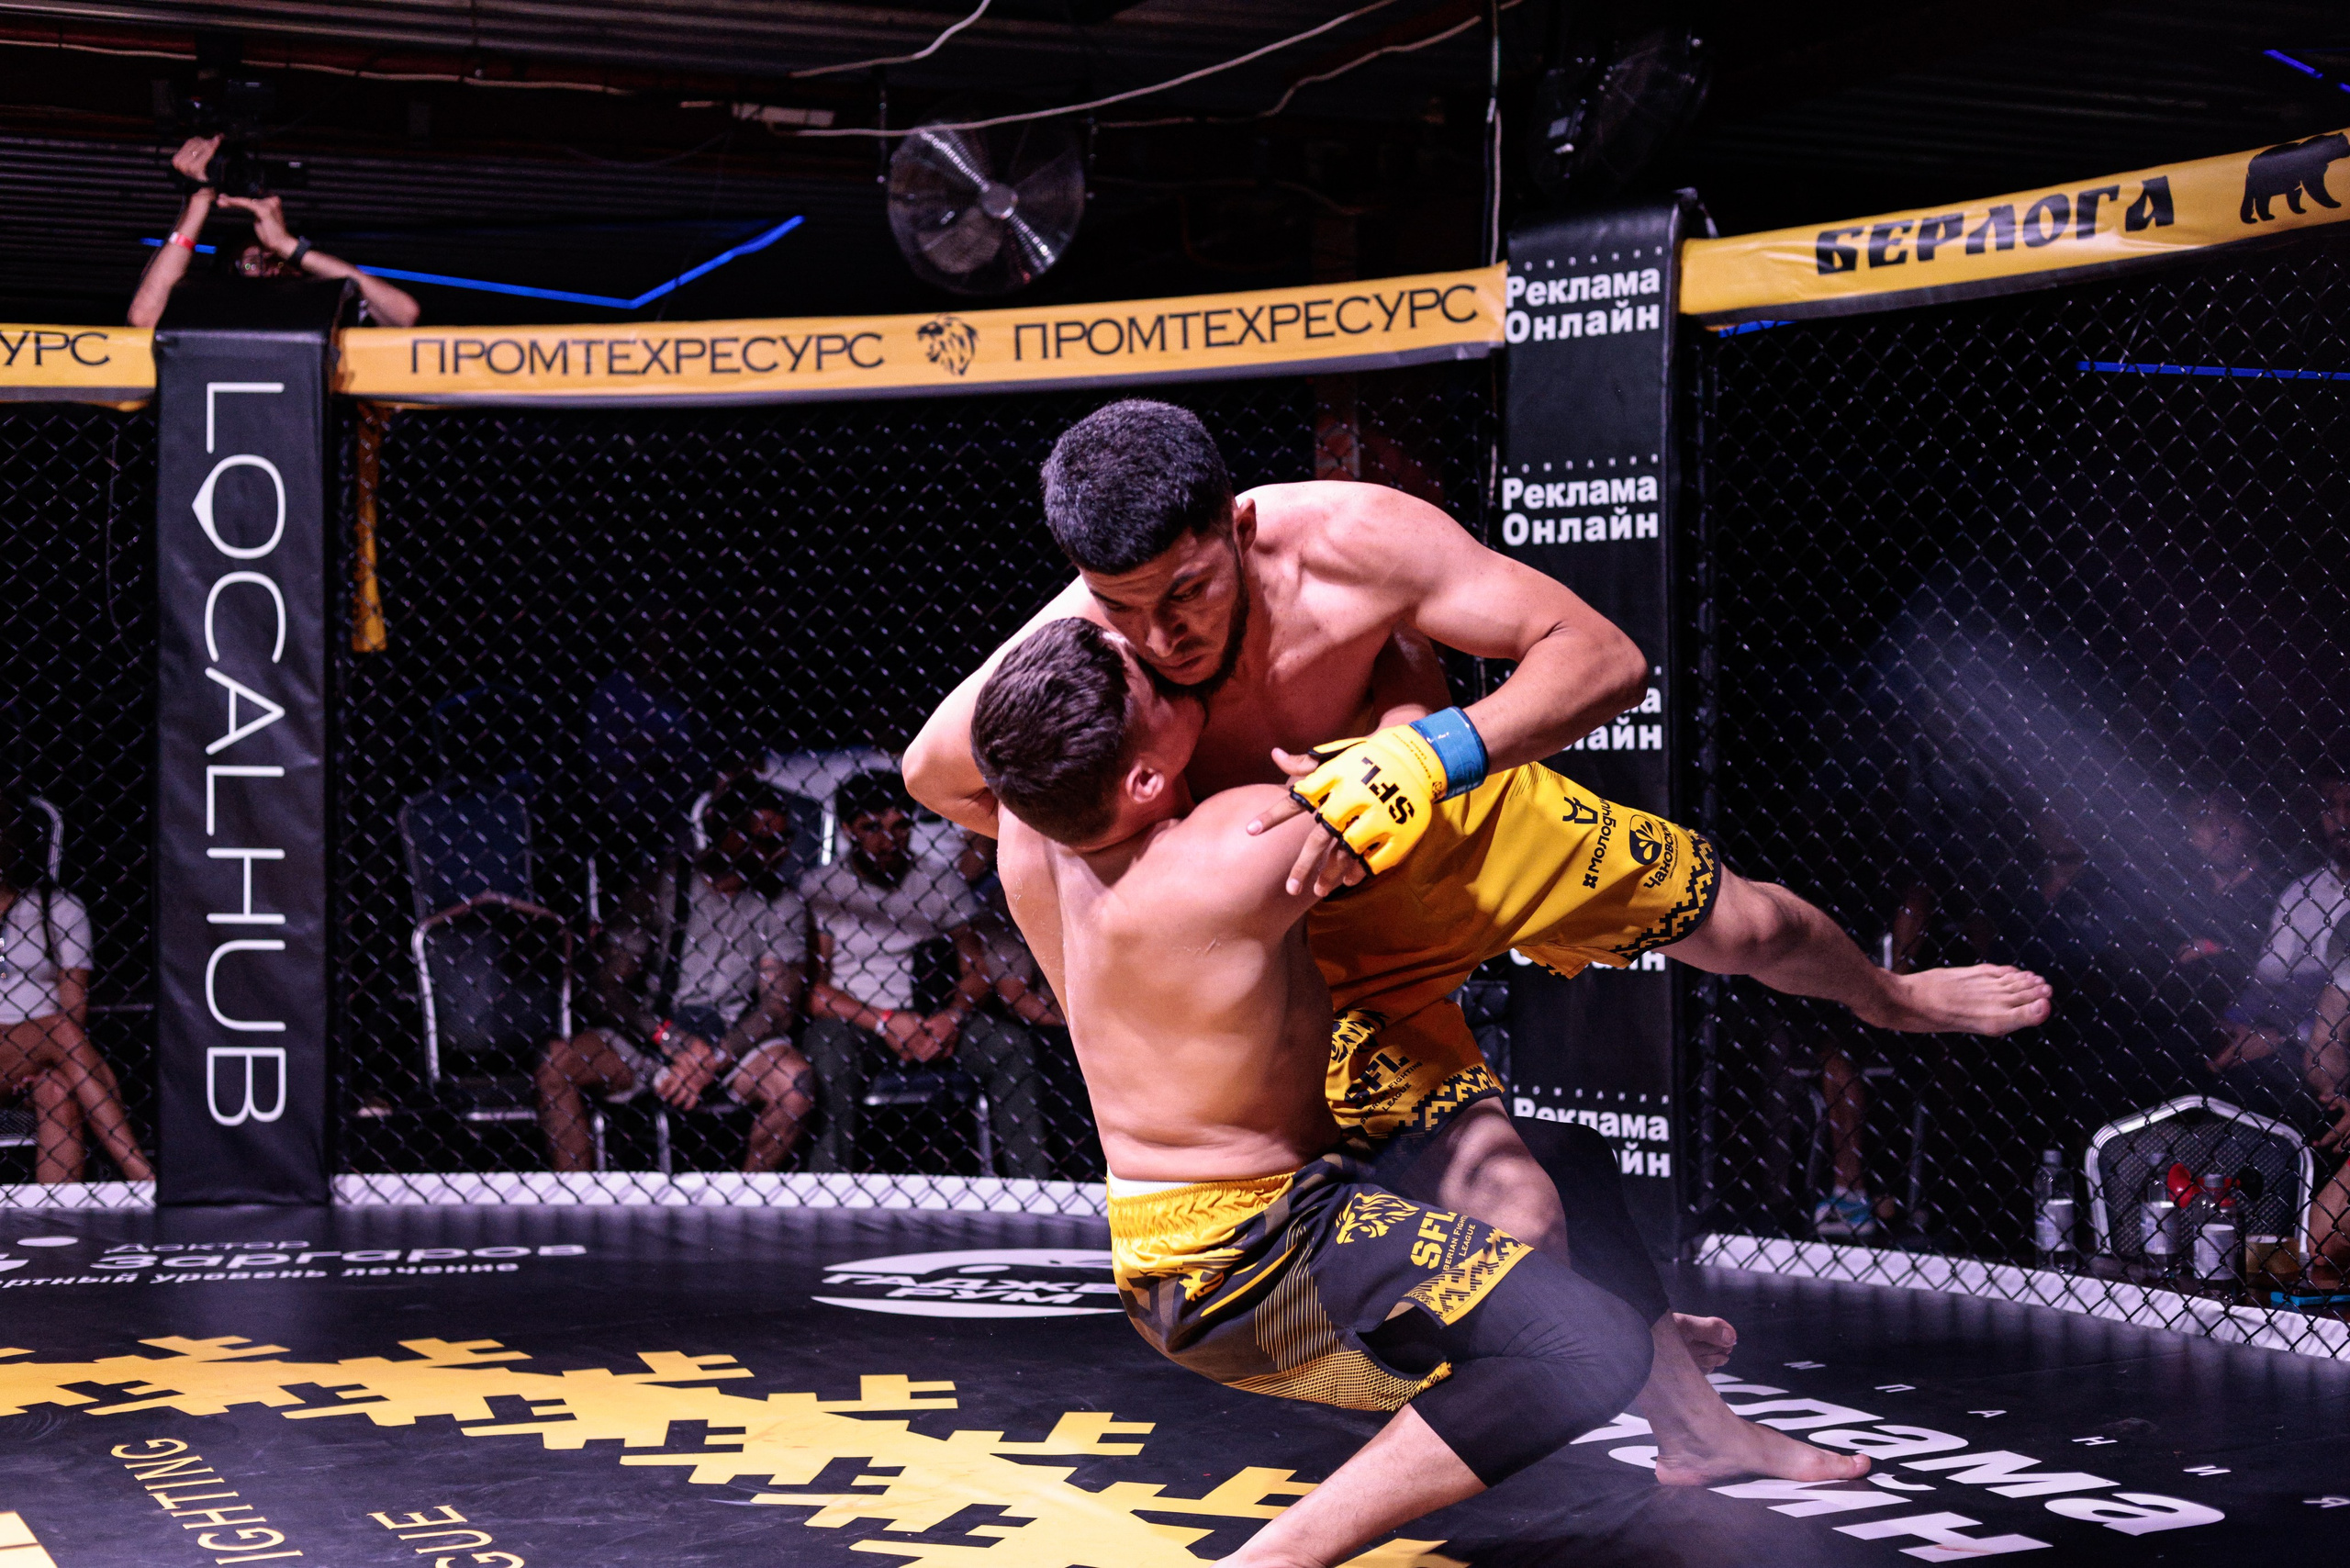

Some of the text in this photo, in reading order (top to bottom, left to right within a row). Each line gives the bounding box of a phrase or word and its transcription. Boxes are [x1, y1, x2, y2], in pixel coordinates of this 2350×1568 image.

[1816, 175, 2175, 275] БЕРЛОГА
[1505, 267, 1661, 309] Реклама
[1014, 284, 1478, 362] ПРОМТЕХРЕСУРС
[1505, 299, 1661, 344] Онлайн
[0, 330, 110, 366] УРС
[410, 331, 885, 376] ПРОМТЕХРЕСУРС
[1502, 476, 1659, 511] Реклама
[1502, 507, 1659, 546] Онлайн
[1561, 716, 1662, 751] айн
[192, 382, 286, 1126] LOCALHUB
[1361, 756, 1416, 825] SFL
[1387, 1060, 1424, 1091] FIGHTING
[1382, 1081, 1412, 1114] LEAGUE
[90, 1244, 588, 1270] Заргаров
[1410, 1210, 1458, 1271] SFL
[1442, 1237, 1459, 1272] BERIAN
[1459, 1223, 1476, 1258] LEAGUE
[0, 1272, 139, 1288] ртный
[150, 1270, 328, 1284] уровень
[822, 1273, 1117, 1294] ГАДЖЕ
[886, 1287, 1083, 1304] РУМ
[1705, 1372, 2225, 1536] лама
